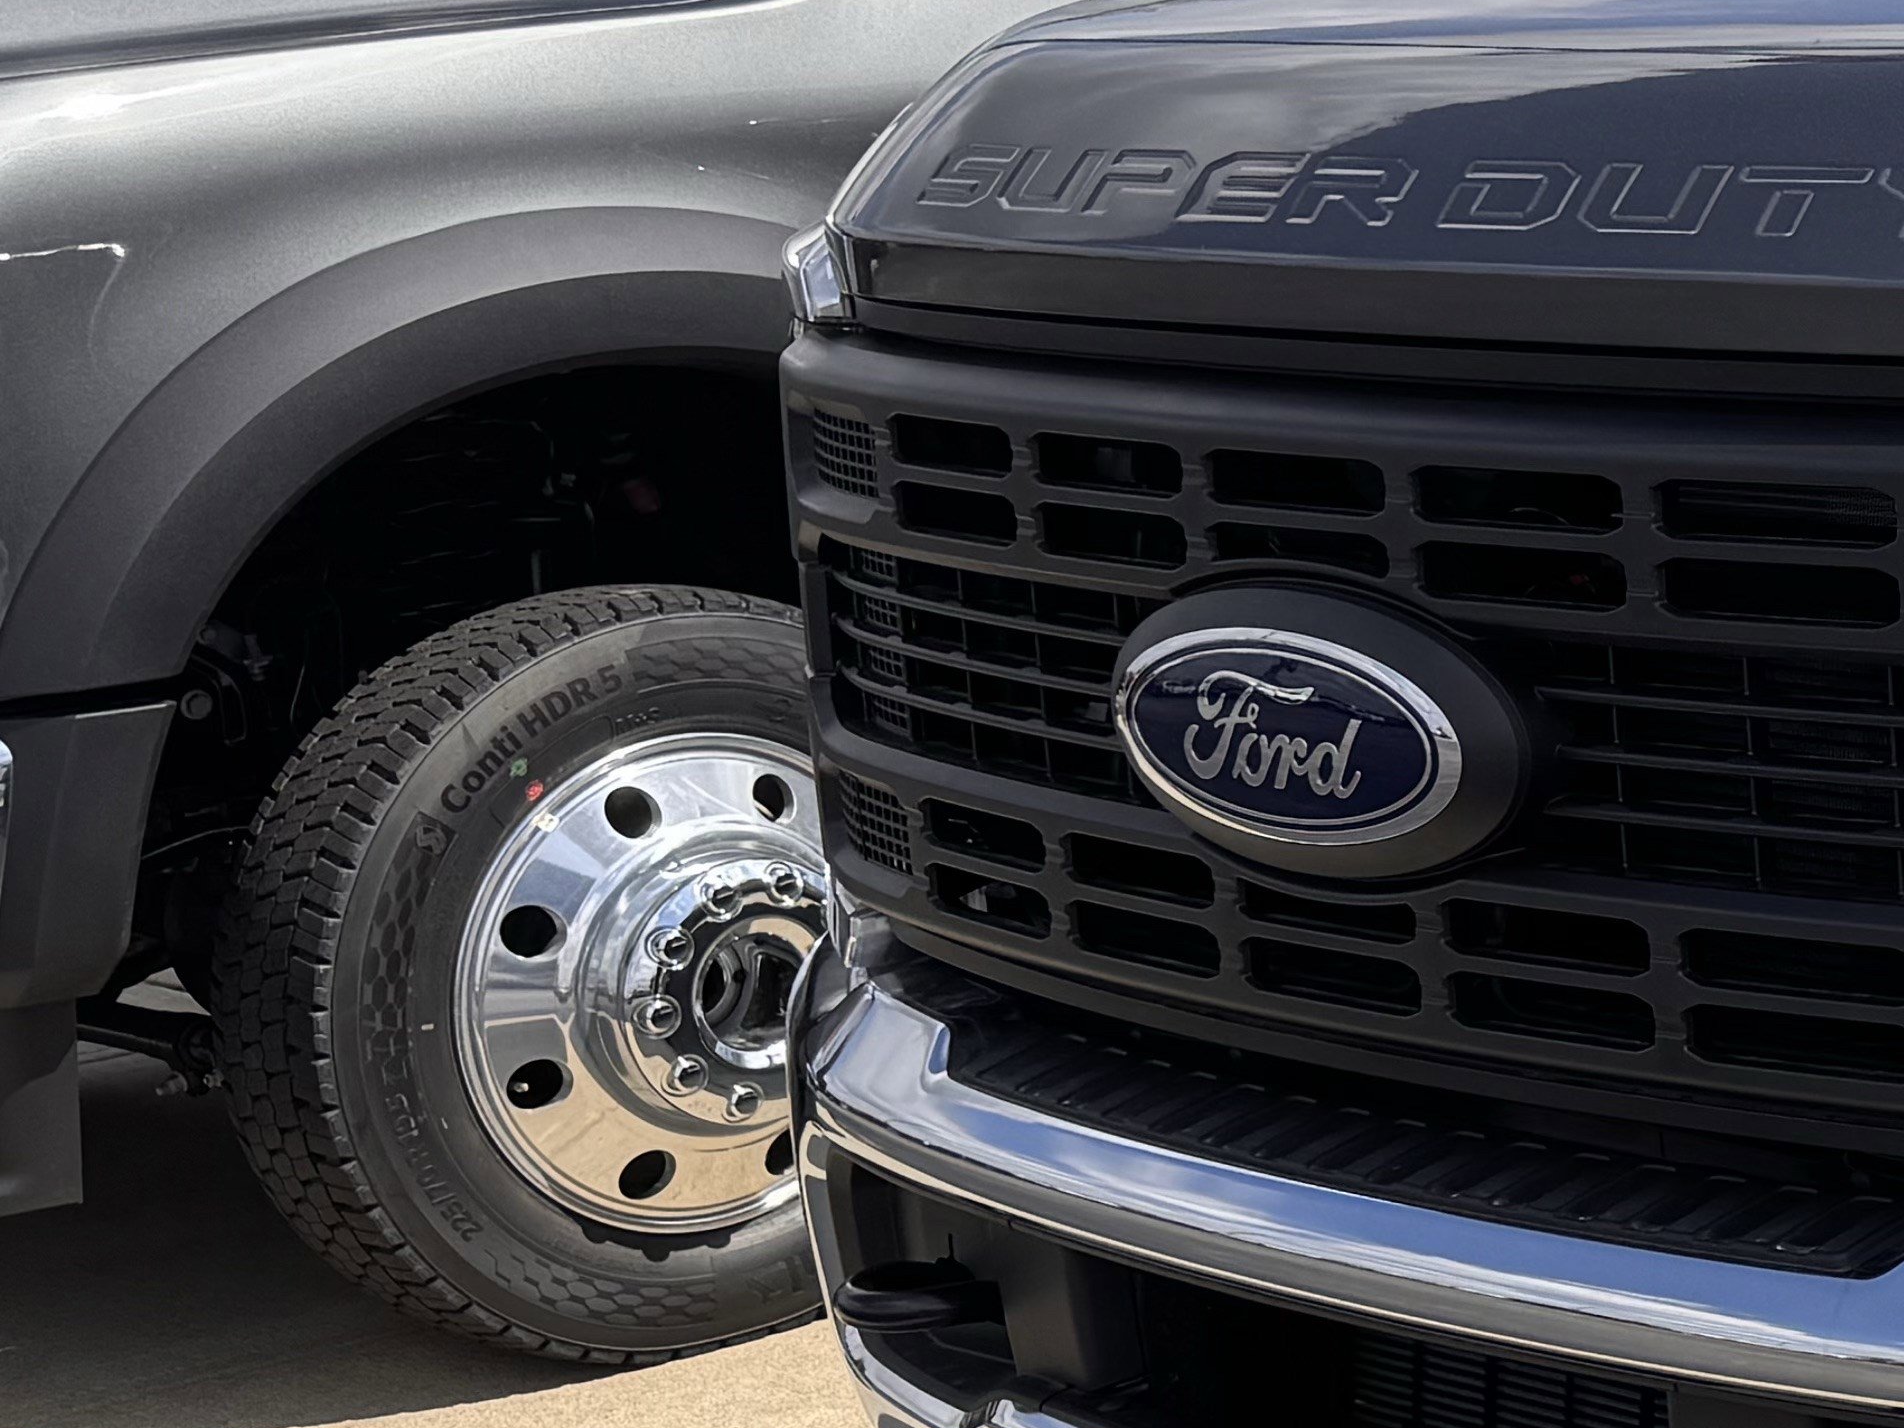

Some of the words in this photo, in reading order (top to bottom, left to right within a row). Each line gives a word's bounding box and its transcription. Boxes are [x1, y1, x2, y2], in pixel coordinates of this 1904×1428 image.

[917, 142, 1419, 228] SUPER
[440, 724, 524, 815] Conti
[516, 676, 599, 740] HDR
[596, 663, 624, 694] 5
[1183, 669, 1363, 800] Ford
